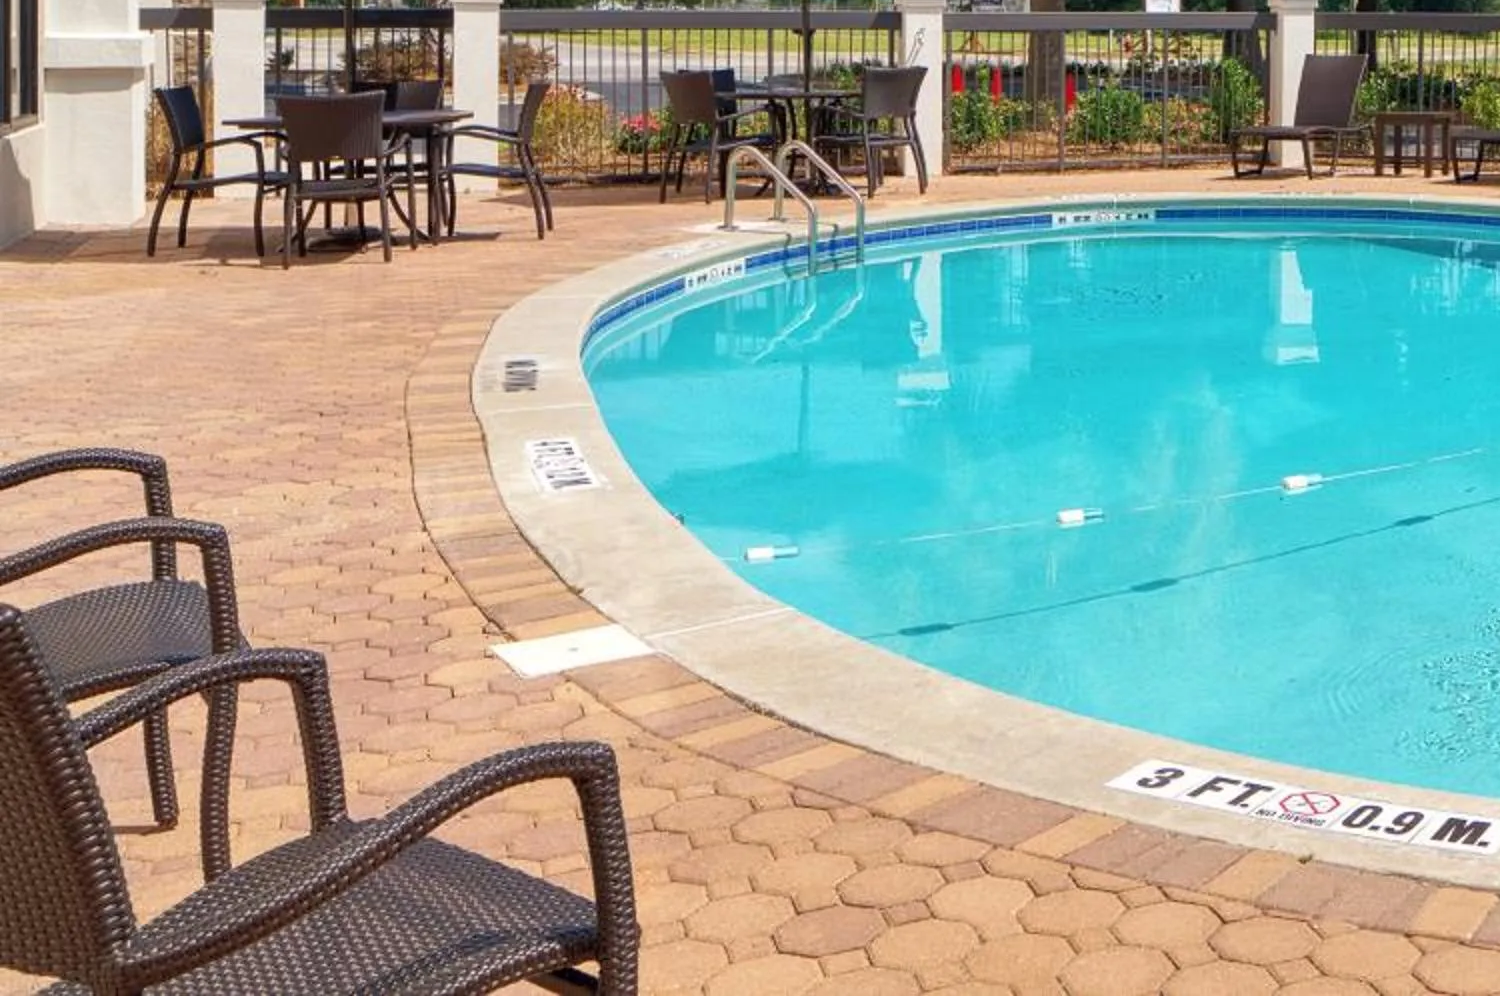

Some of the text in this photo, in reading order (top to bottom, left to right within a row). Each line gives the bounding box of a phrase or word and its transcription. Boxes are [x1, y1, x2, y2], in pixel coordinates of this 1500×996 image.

[1136, 766, 1496, 848] 3 FT. 0.9 M.
